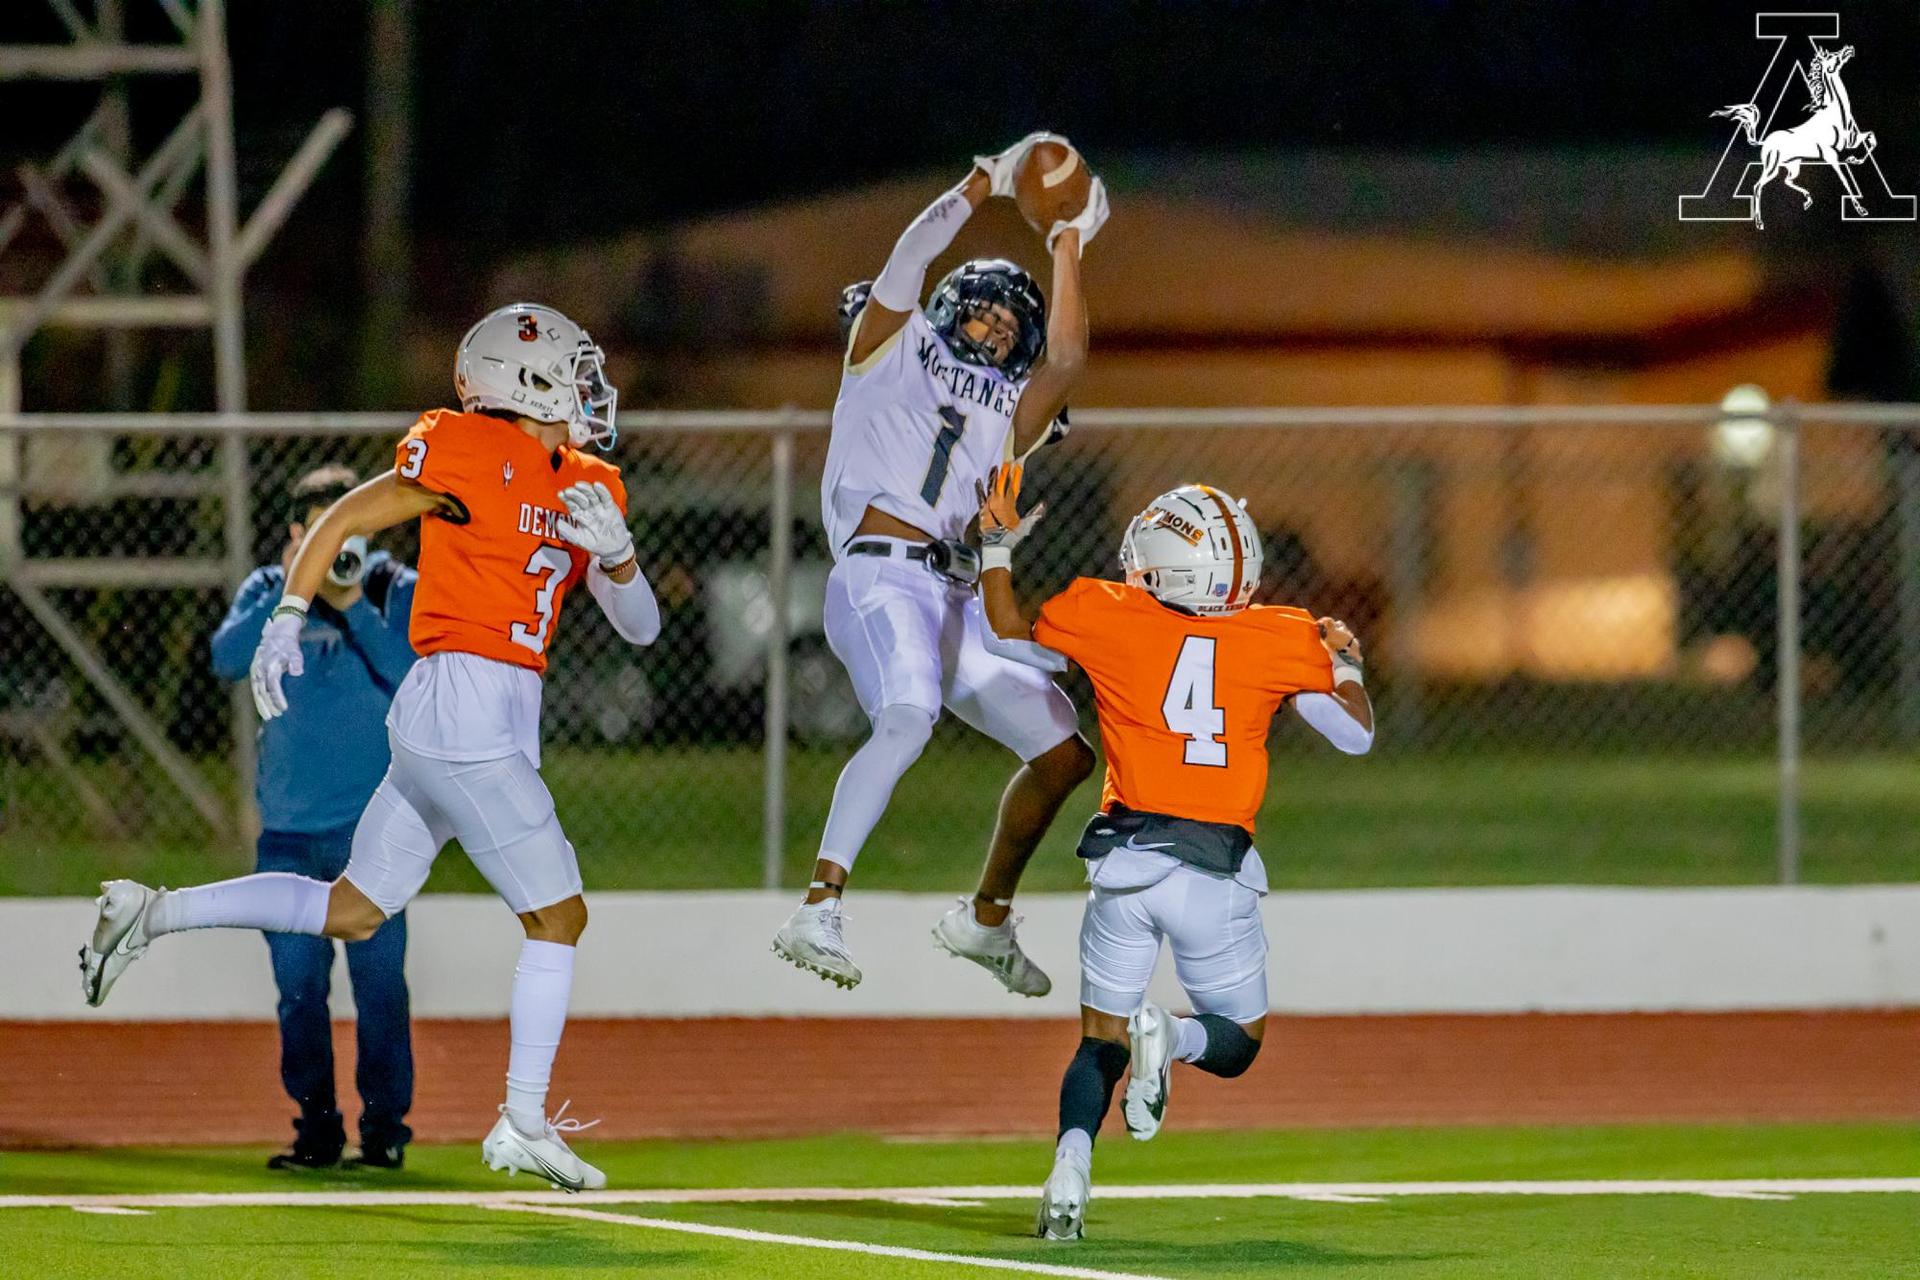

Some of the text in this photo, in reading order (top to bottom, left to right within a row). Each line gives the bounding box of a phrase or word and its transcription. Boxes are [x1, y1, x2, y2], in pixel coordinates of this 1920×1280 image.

[516, 314, 540, 342] 3
[918, 336, 1020, 418] MUTANGS
[400, 438, 428, 480] 3
[920, 404, 967, 509] 1
[1150, 506, 1204, 541] MONS
[510, 543, 573, 655] 3
[1160, 633, 1229, 769] 4
